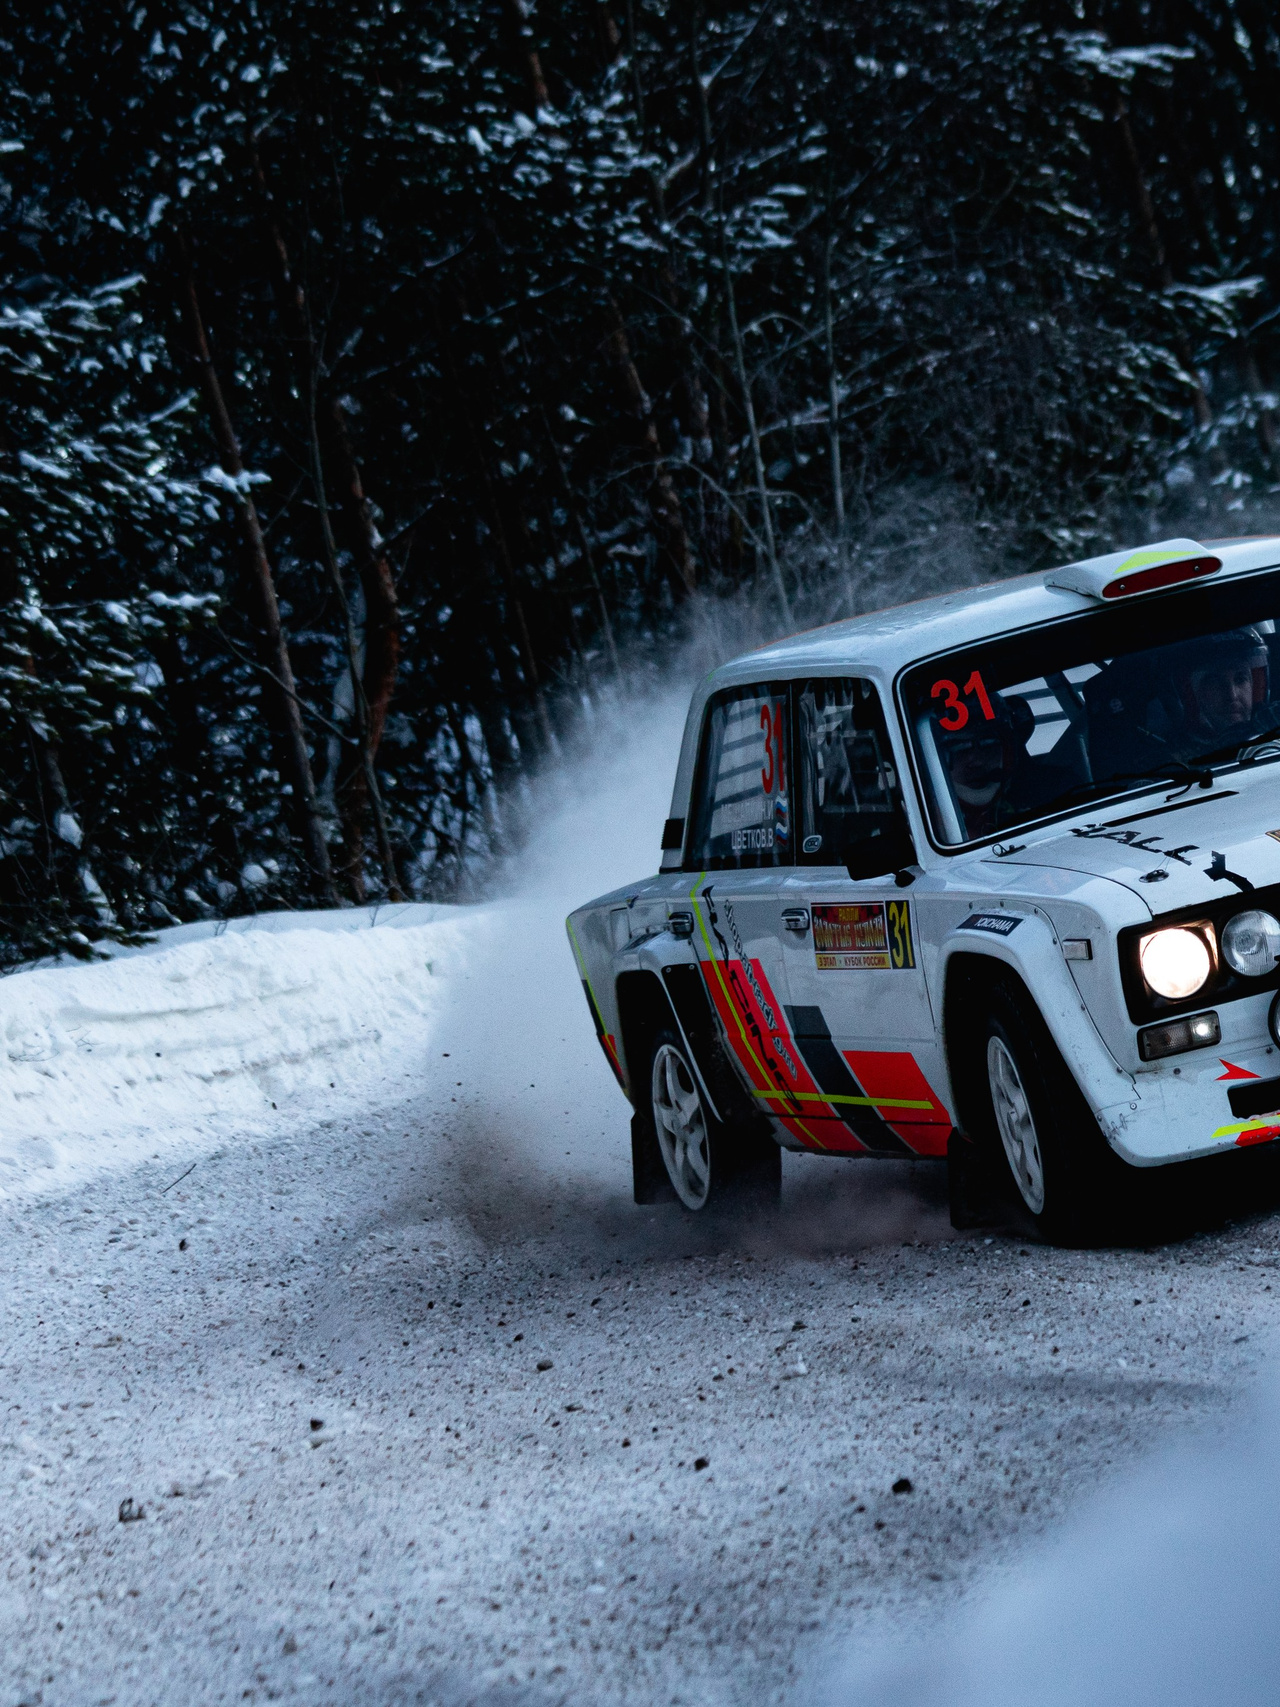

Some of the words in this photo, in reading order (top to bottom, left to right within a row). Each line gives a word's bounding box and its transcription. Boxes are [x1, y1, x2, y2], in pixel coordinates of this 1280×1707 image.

[931, 670, 996, 732] 31
[760, 702, 785, 794] 31
[731, 828, 774, 850] ЦВЕТКОВ.В
[889, 901, 914, 968] 31
[974, 917, 1015, 932] YOKOHAMA
[823, 956, 837, 967] ЭТАП
[844, 957, 862, 967] КУБОК
[863, 956, 887, 967] РОССИИ
